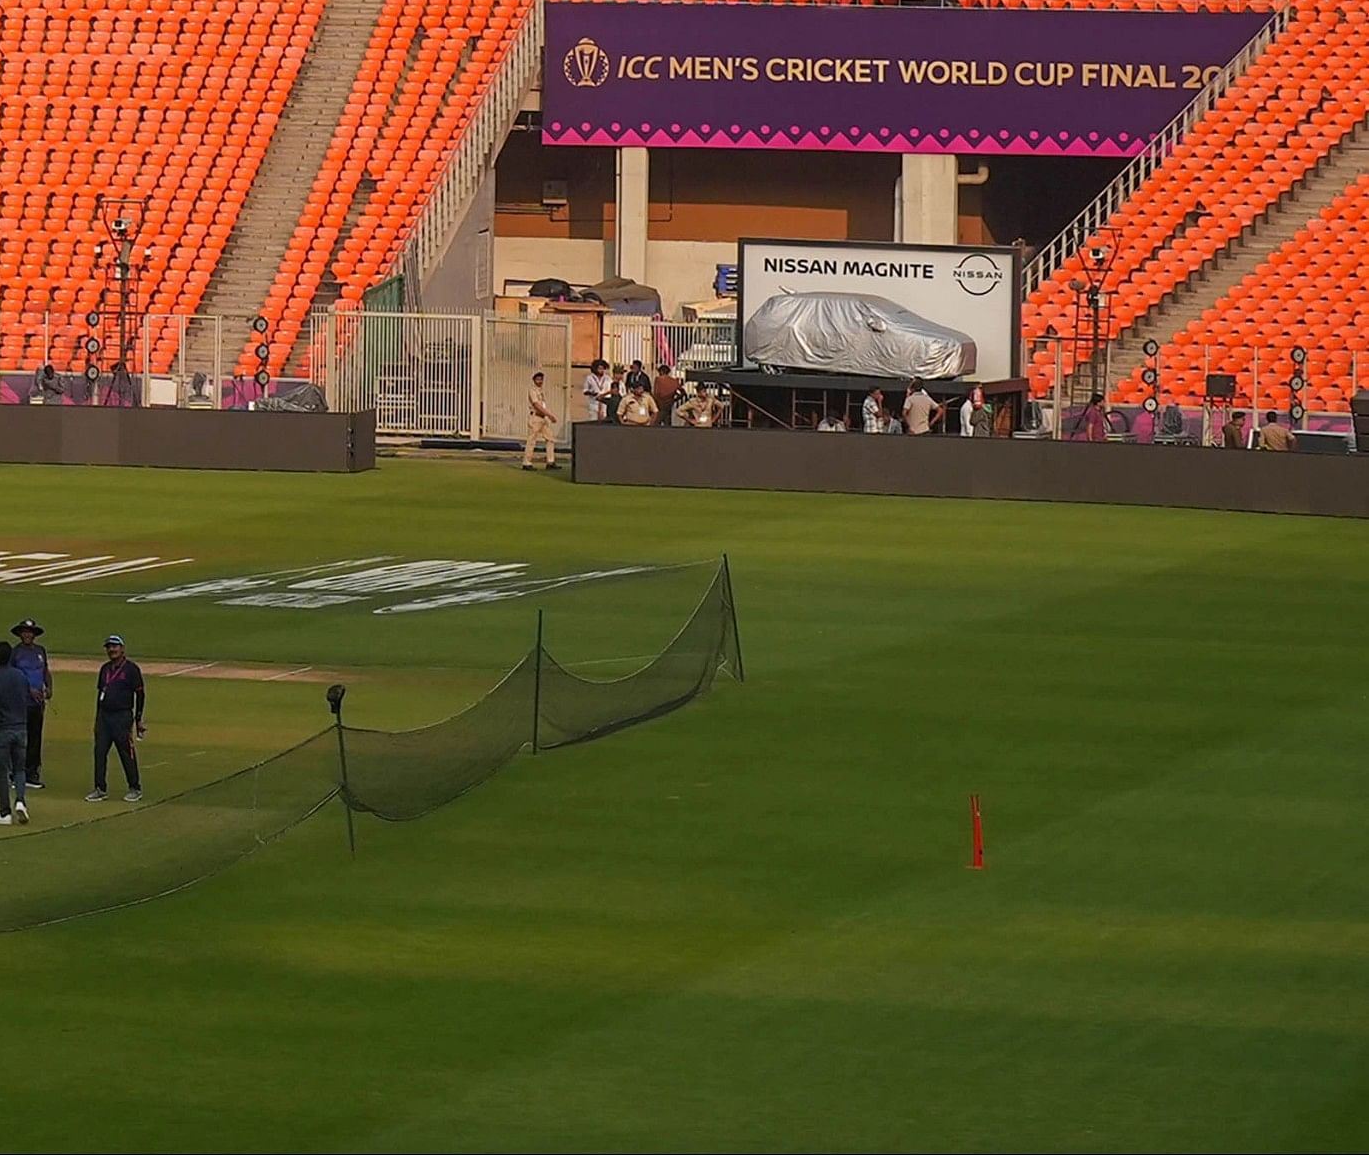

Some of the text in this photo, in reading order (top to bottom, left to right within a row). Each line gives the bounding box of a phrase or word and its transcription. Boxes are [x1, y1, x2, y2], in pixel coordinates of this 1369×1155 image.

[618, 55, 663, 79] ICC
[669, 56, 758, 81] MEN'S
[765, 57, 890, 83] CRICKET
[897, 60, 1008, 85] WORLD
[1014, 62, 1074, 86] CUP
[1082, 63, 1176, 88] FINAL
[764, 257, 934, 279] NISSAN MAGNITE
[953, 269, 1003, 279] NISSAN
